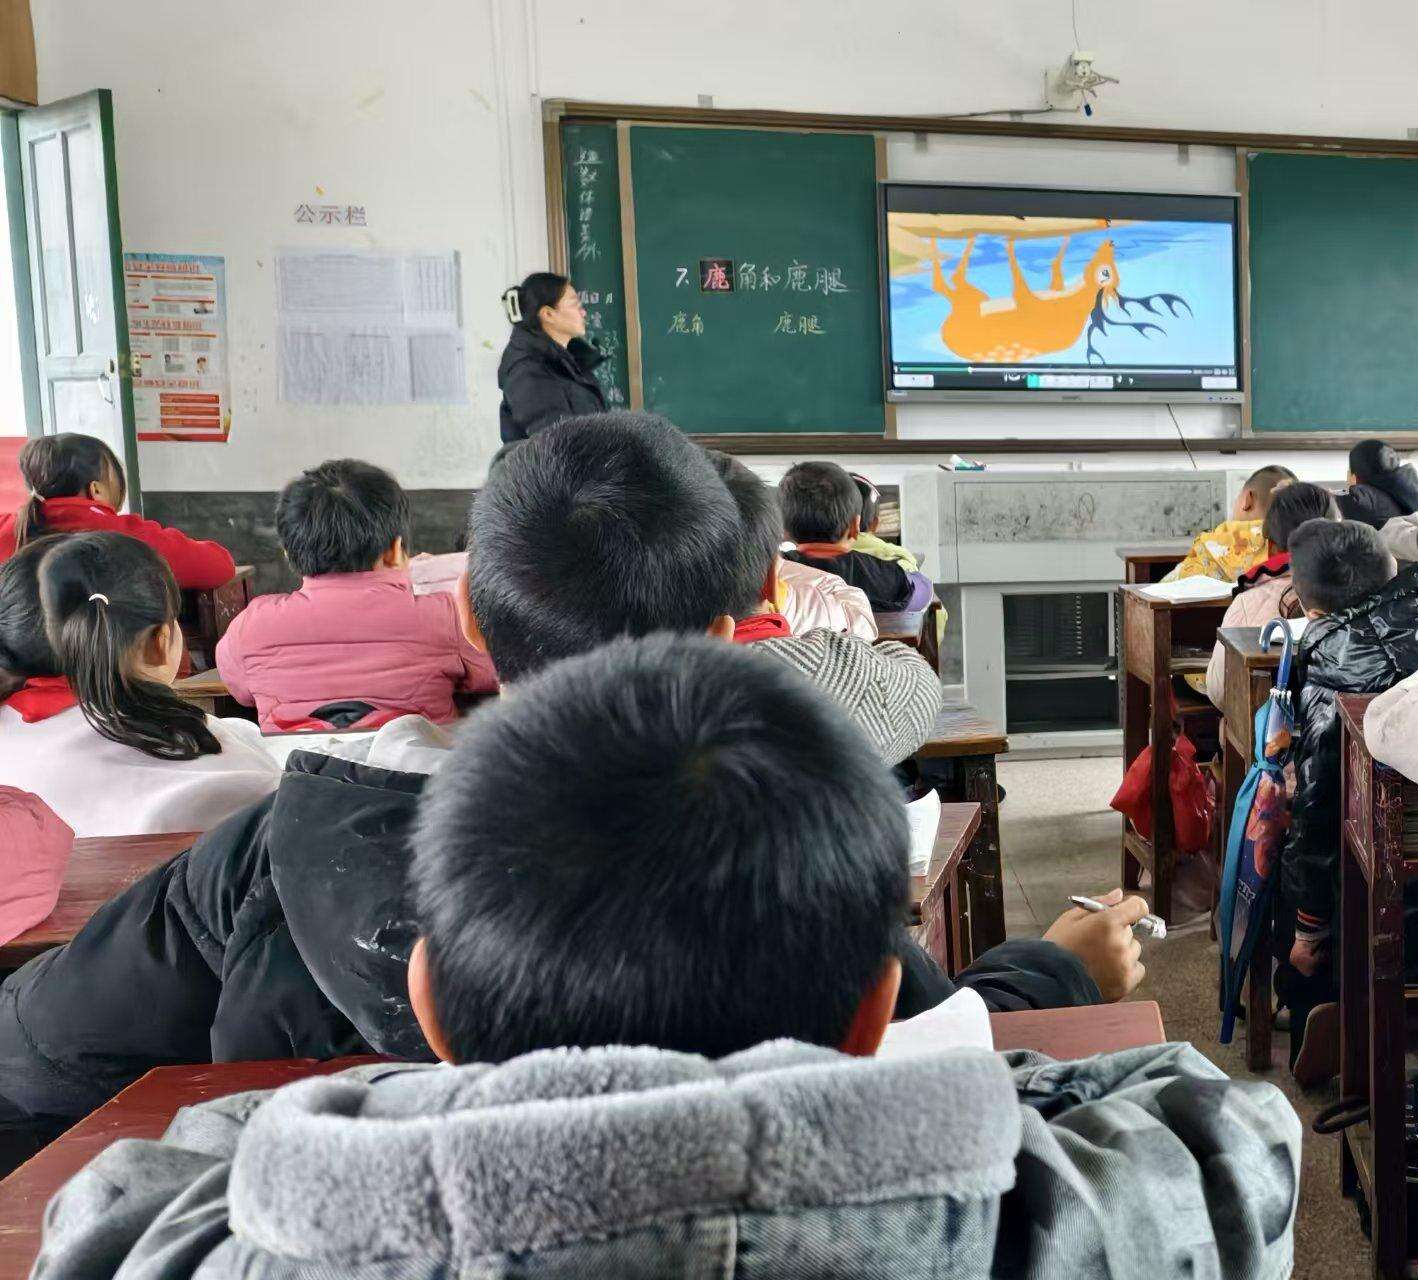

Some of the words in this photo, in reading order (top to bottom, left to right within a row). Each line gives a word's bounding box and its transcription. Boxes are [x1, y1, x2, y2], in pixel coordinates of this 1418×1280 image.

[294, 203, 368, 227] 公示栏
[667, 311, 704, 336] 鹿角
[773, 311, 828, 336] 鹿腿
